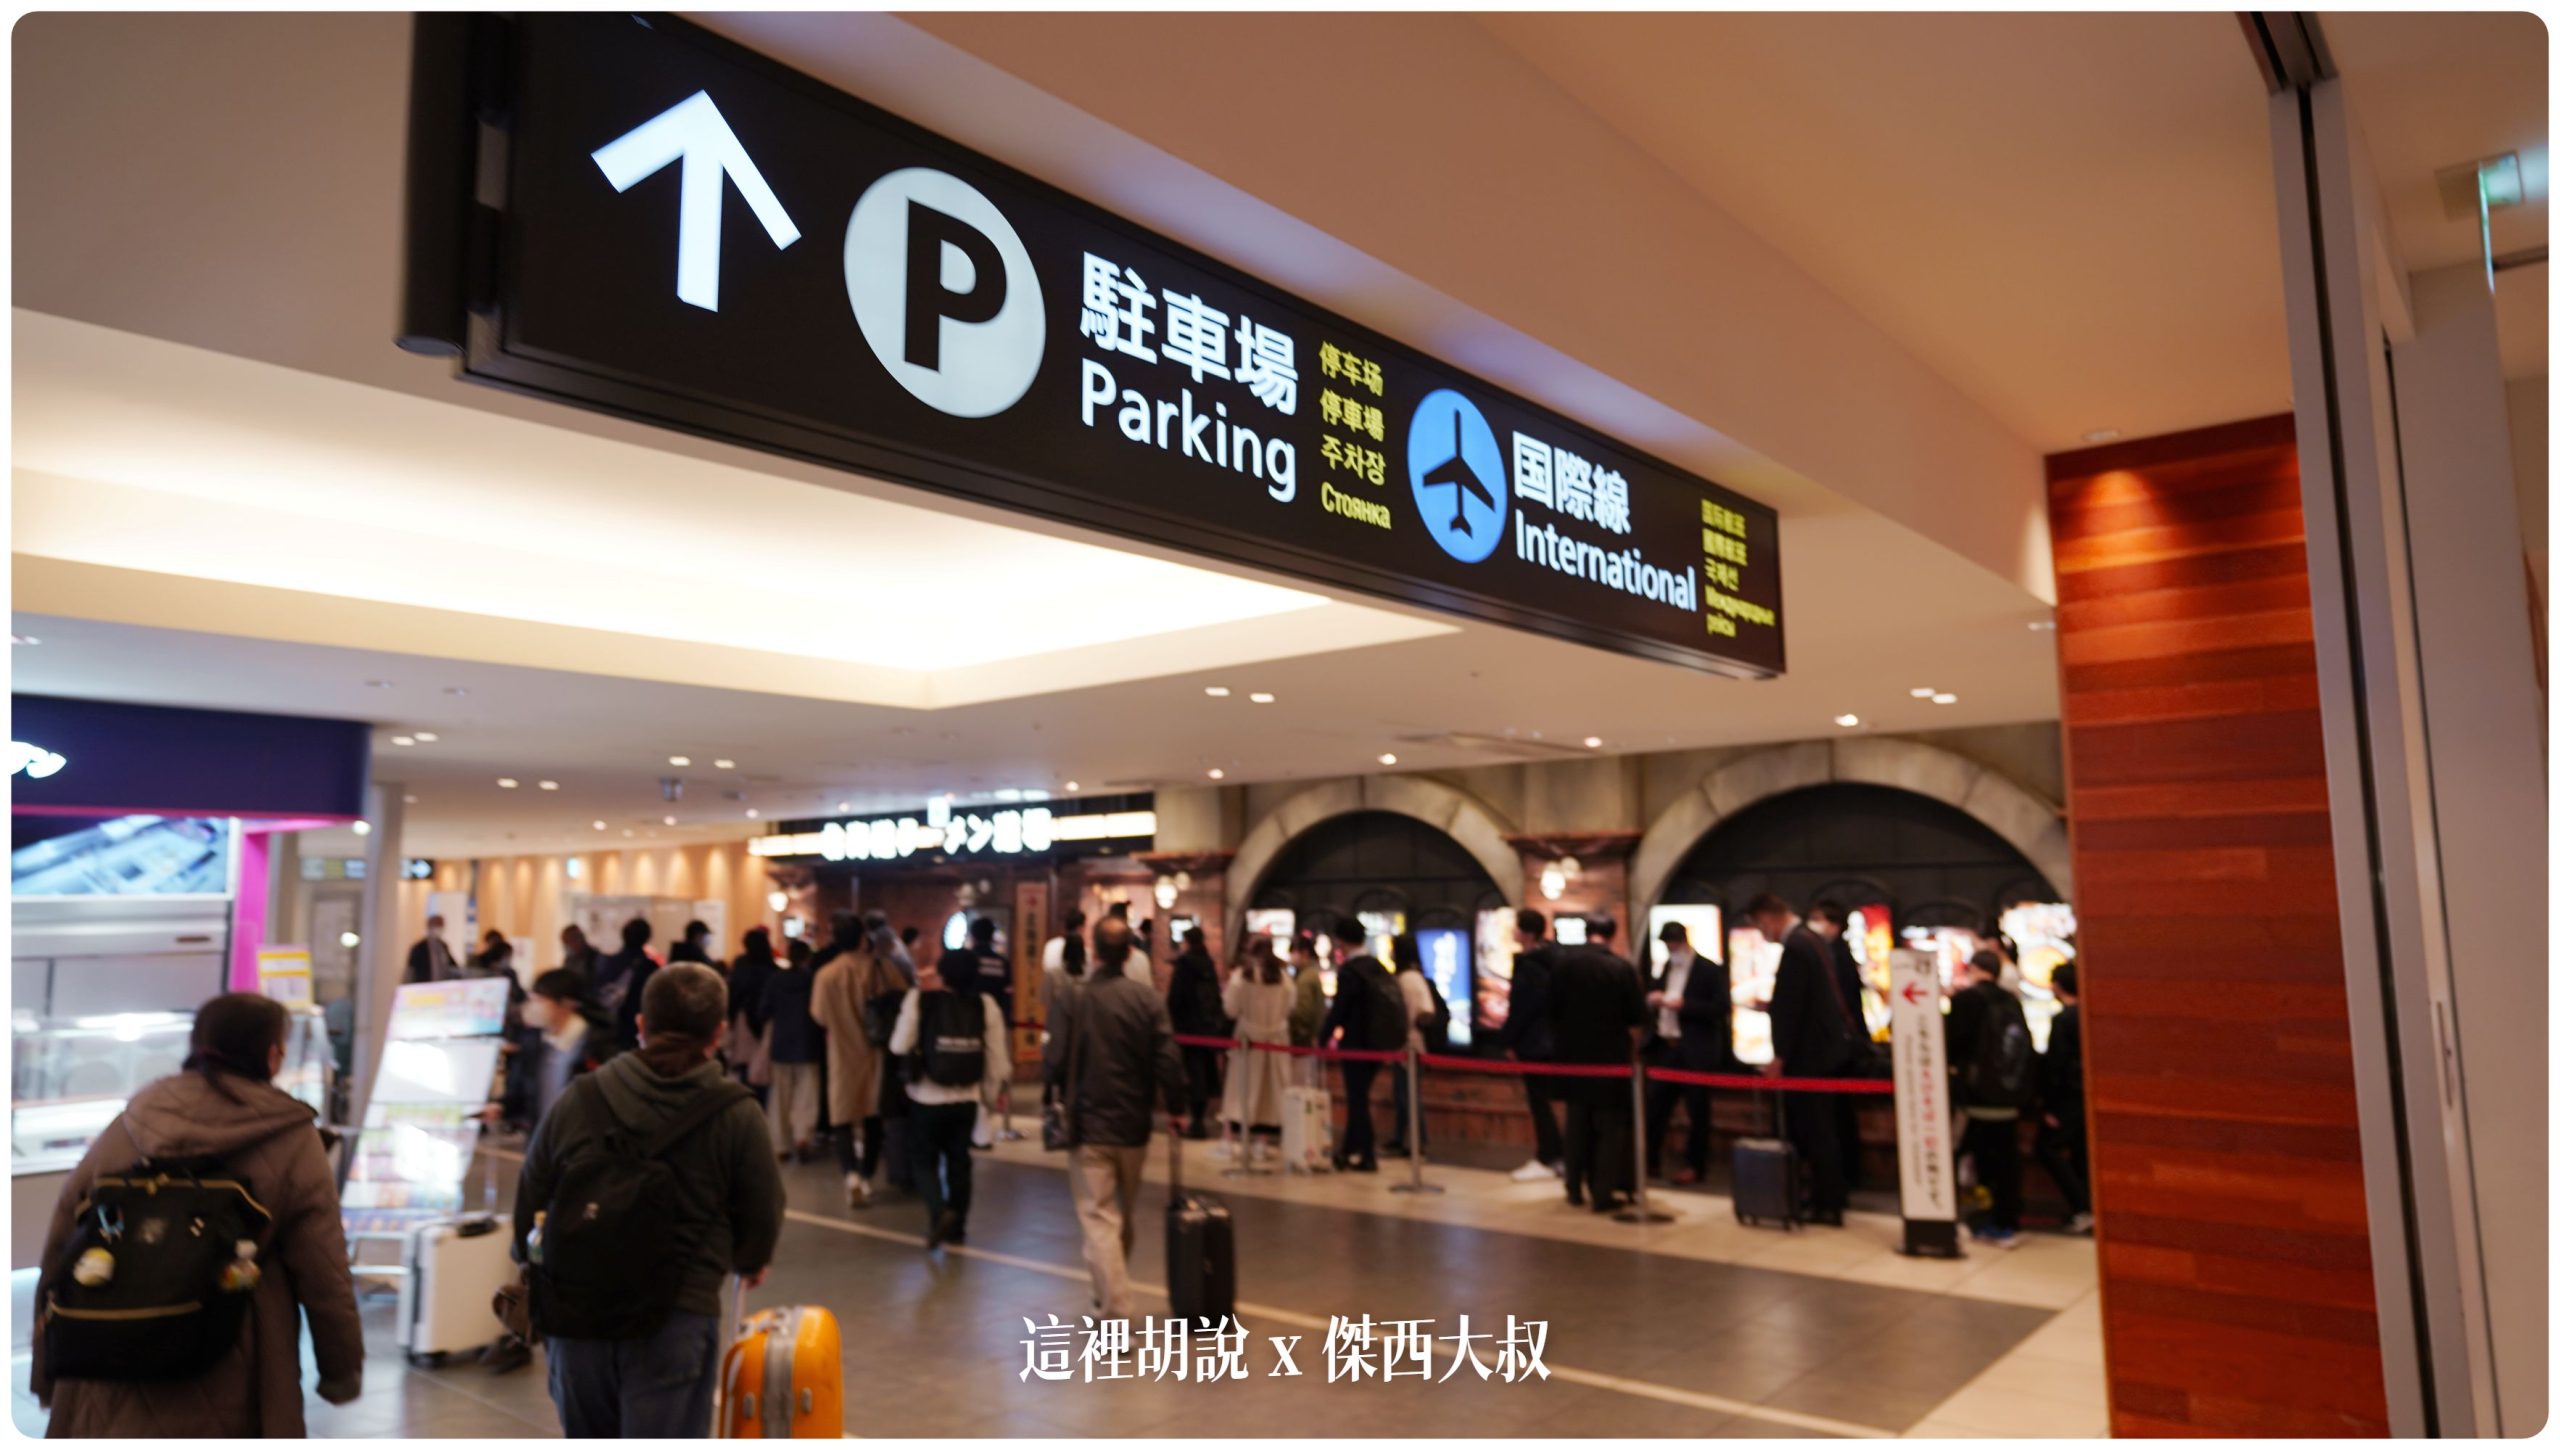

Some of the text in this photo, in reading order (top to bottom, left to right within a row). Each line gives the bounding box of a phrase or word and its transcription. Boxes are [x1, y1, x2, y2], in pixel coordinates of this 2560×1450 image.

[904, 198, 1007, 373] P
[1080, 251, 1298, 415] 駐車場
[1319, 341, 1384, 396] 停车场
[1320, 388, 1385, 442] 停車場
[1082, 358, 1297, 503] Parking
[1320, 434, 1387, 487] 주차장
[1512, 430, 1632, 535] 国際線
[1320, 481, 1392, 530] Стоянка
[1515, 508, 1698, 612] International
